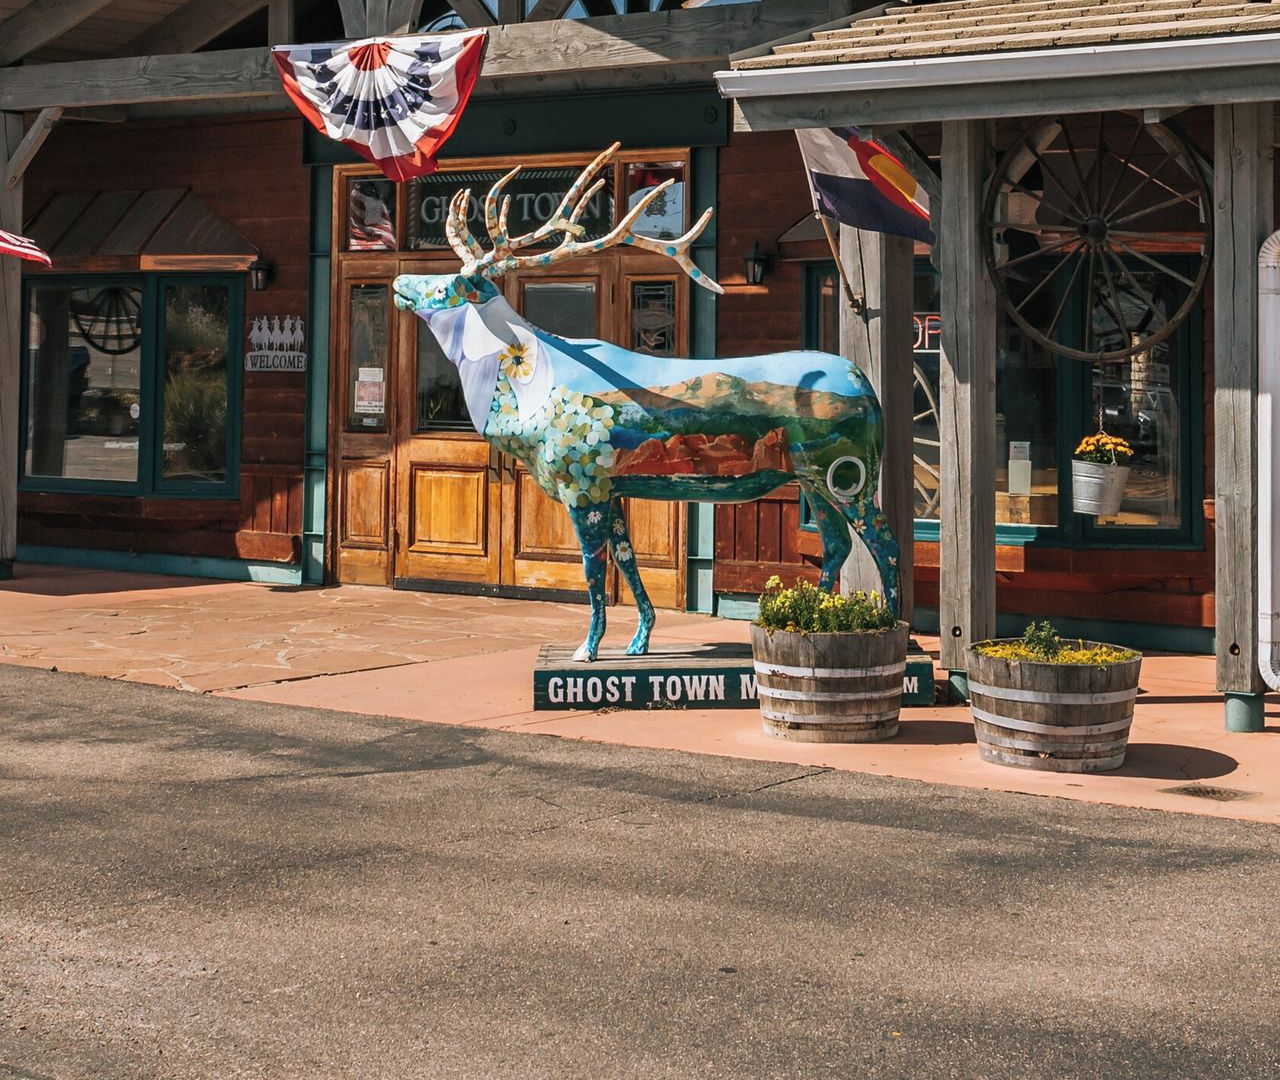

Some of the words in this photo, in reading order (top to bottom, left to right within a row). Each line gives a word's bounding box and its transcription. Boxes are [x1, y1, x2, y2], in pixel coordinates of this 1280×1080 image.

[250, 354, 303, 369] WELCOME
[548, 676, 636, 703] GHOST
[648, 674, 725, 701] TOWN
